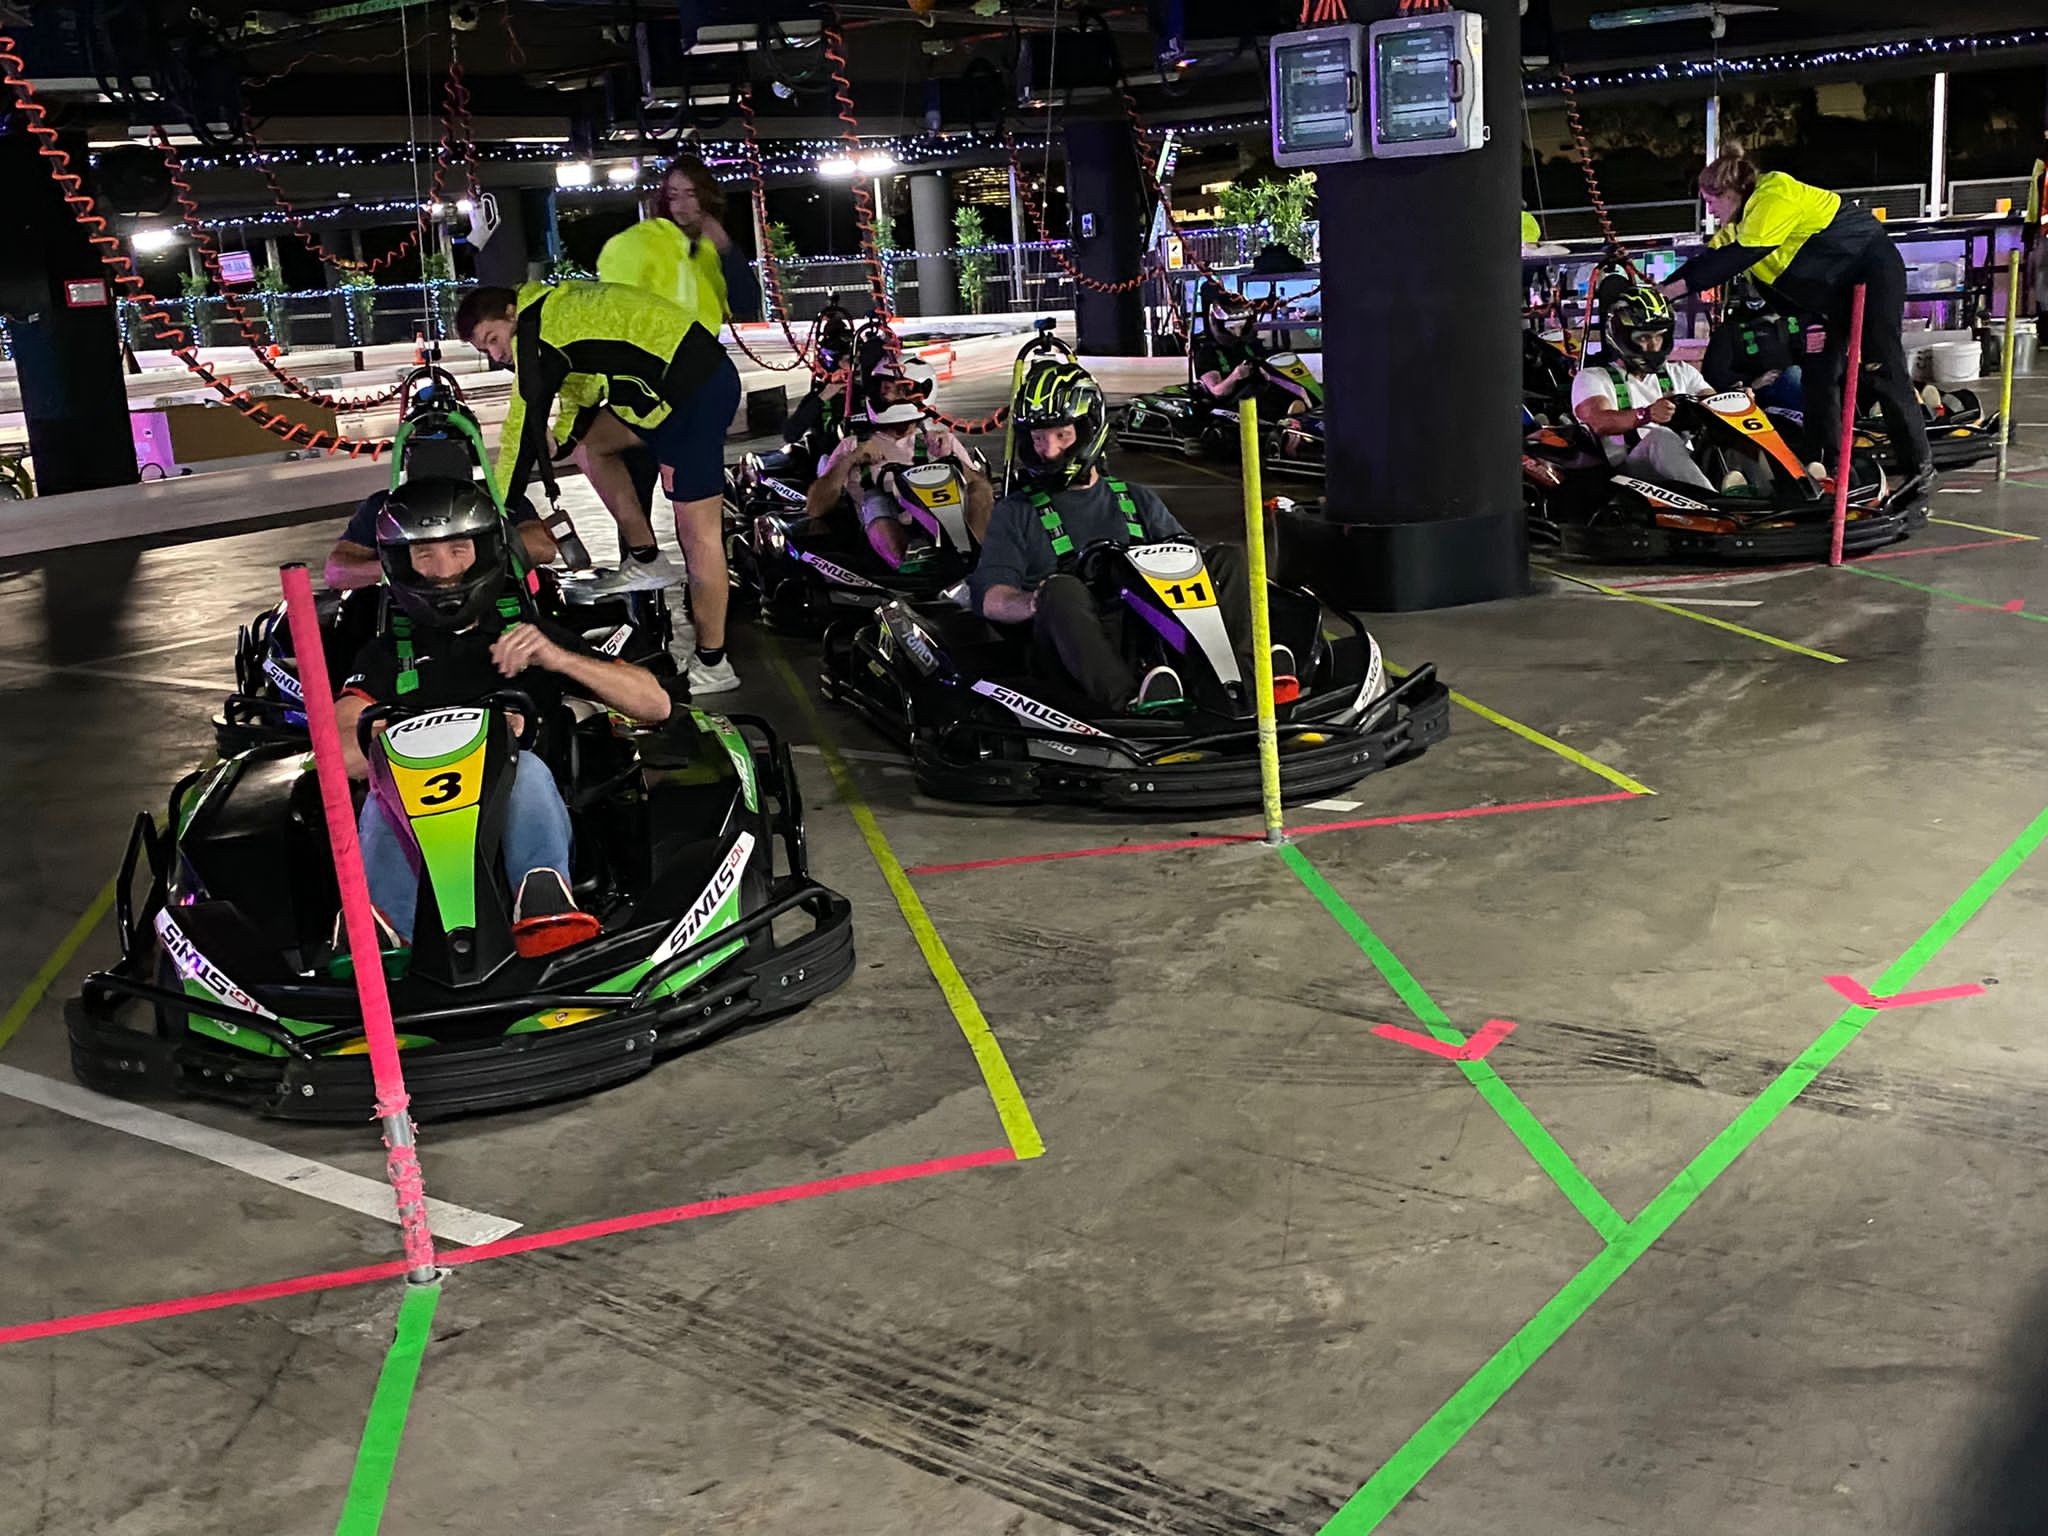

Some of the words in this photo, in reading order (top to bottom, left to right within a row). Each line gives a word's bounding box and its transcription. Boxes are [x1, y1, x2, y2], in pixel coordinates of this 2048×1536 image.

[1742, 418, 1764, 431] 6
[932, 489, 952, 504] 5
[1164, 582, 1207, 604] 11
[420, 771, 462, 806] 3
